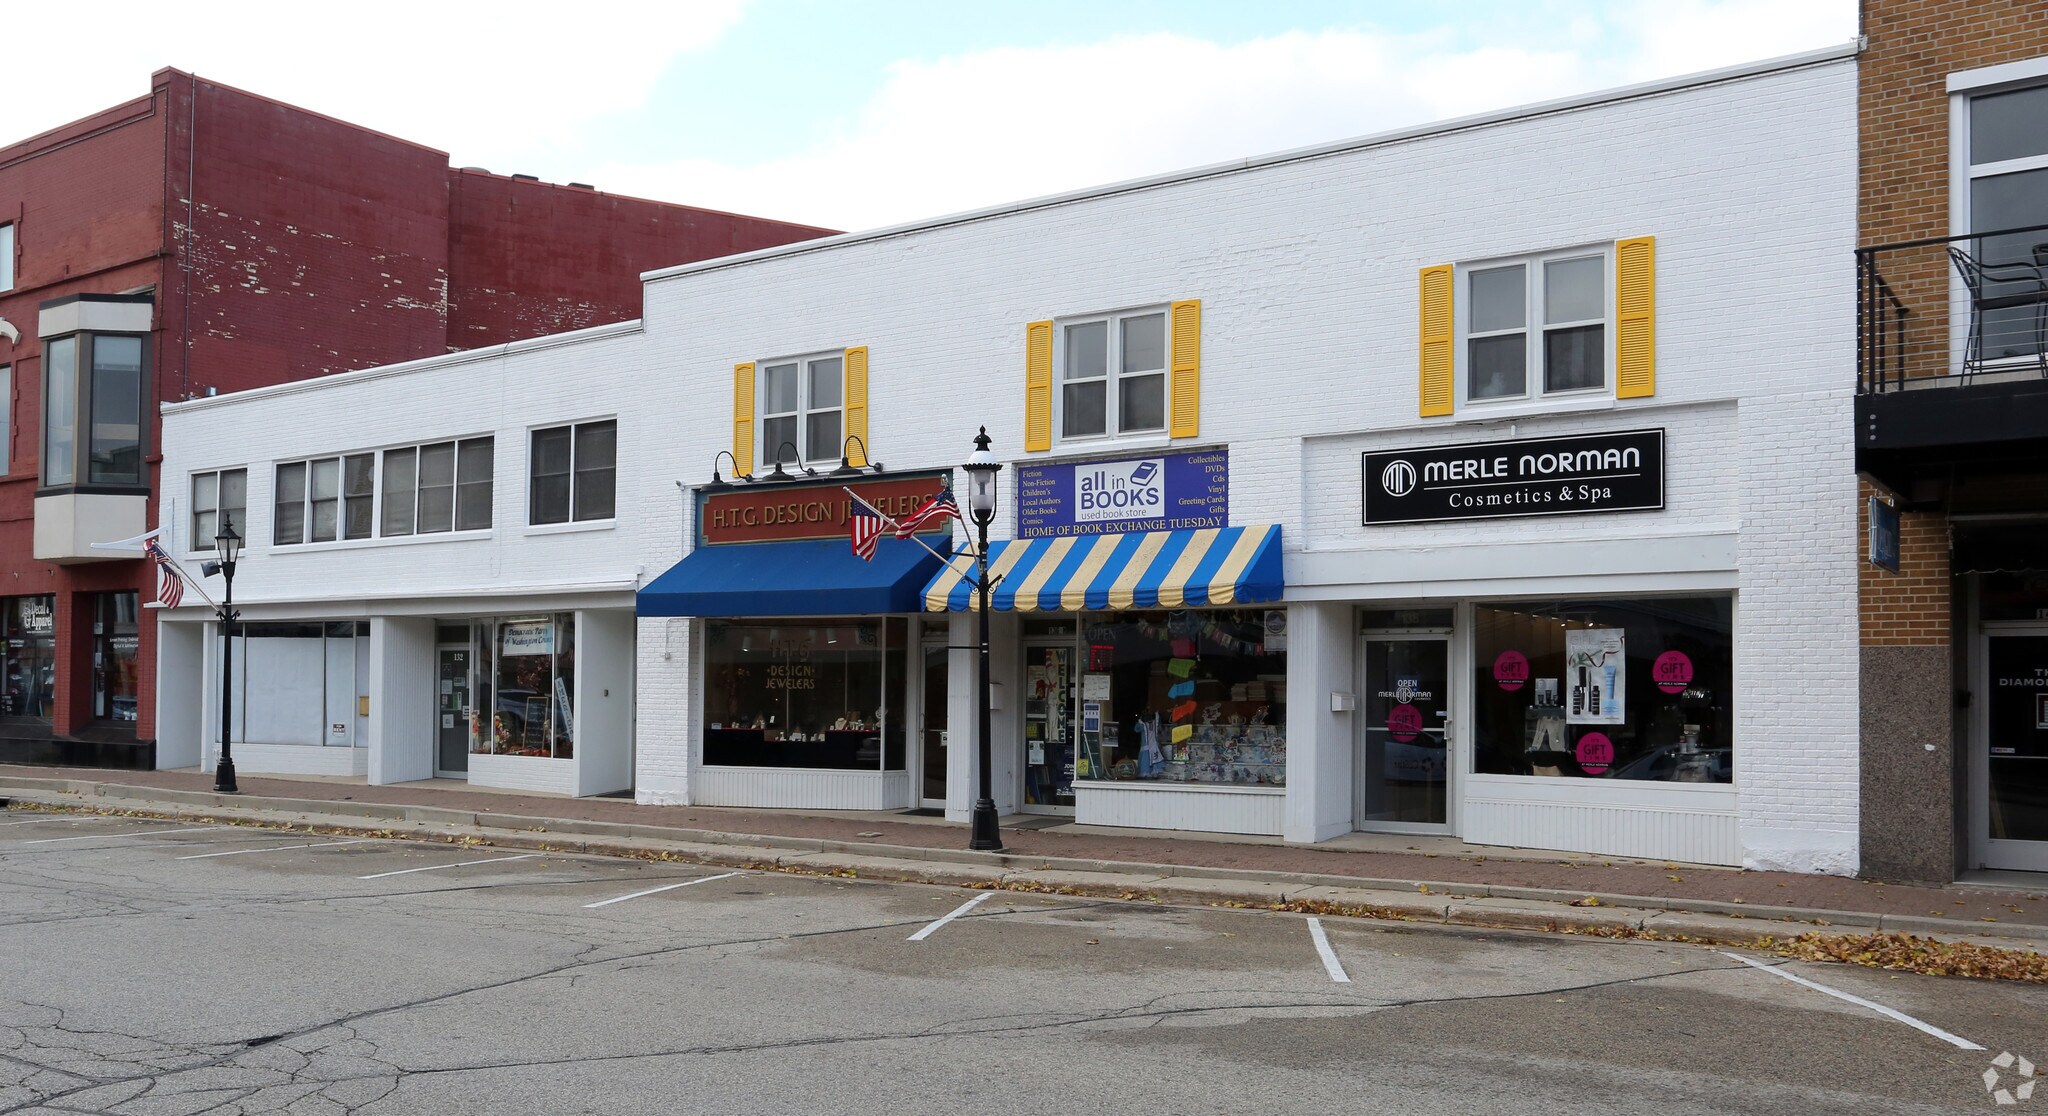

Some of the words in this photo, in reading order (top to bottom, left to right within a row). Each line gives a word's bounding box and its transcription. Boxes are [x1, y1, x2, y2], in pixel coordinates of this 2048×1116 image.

[1188, 455, 1225, 464] Collectibles
[1424, 456, 1508, 482] MERLE
[1519, 447, 1640, 476] NORMAN
[1022, 470, 1042, 478] Fiction
[1205, 464, 1225, 473] DVDs
[1022, 478, 1056, 487] Non-Fiction
[1081, 471, 1106, 490] all
[1111, 474, 1125, 490] in
[1212, 474, 1225, 483] Cds
[1208, 485, 1225, 494] Vinyl
[1022, 498, 1039, 506] Local
[1040, 496, 1061, 505] Authors
[1081, 487, 1159, 510] BOOKS
[1178, 496, 1206, 506] Greeting
[1206, 495, 1225, 504] Cards
[1449, 487, 1552, 508] Cosmetics
[1558, 486, 1574, 501] &
[1578, 485, 1612, 504] Spa
[713, 506, 760, 528] H.T.G.
[764, 502, 832, 525] DESIGN
[1081, 510, 1100, 520] used
[1102, 508, 1124, 518] book
[1126, 508, 1146, 517] store
[1209, 505, 1225, 514] Gifts
[1024, 526, 1054, 537] HOME
[1057, 525, 1070, 535] OF
[1073, 523, 1102, 534] BOOK
[1106, 521, 1166, 533] EXCHANGE
[1169, 516, 1223, 529] TUESDAY
[1088, 628, 1116, 640] OPEN
[771, 665, 811, 676] DESIGN
[1501, 662, 1522, 672] GIFT
[1661, 663, 1685, 674] GIFT
[766, 678, 815, 689] JEWELERS
[1057, 650, 1066, 742] WELCOME
[1584, 744, 1606, 755] GIFT
